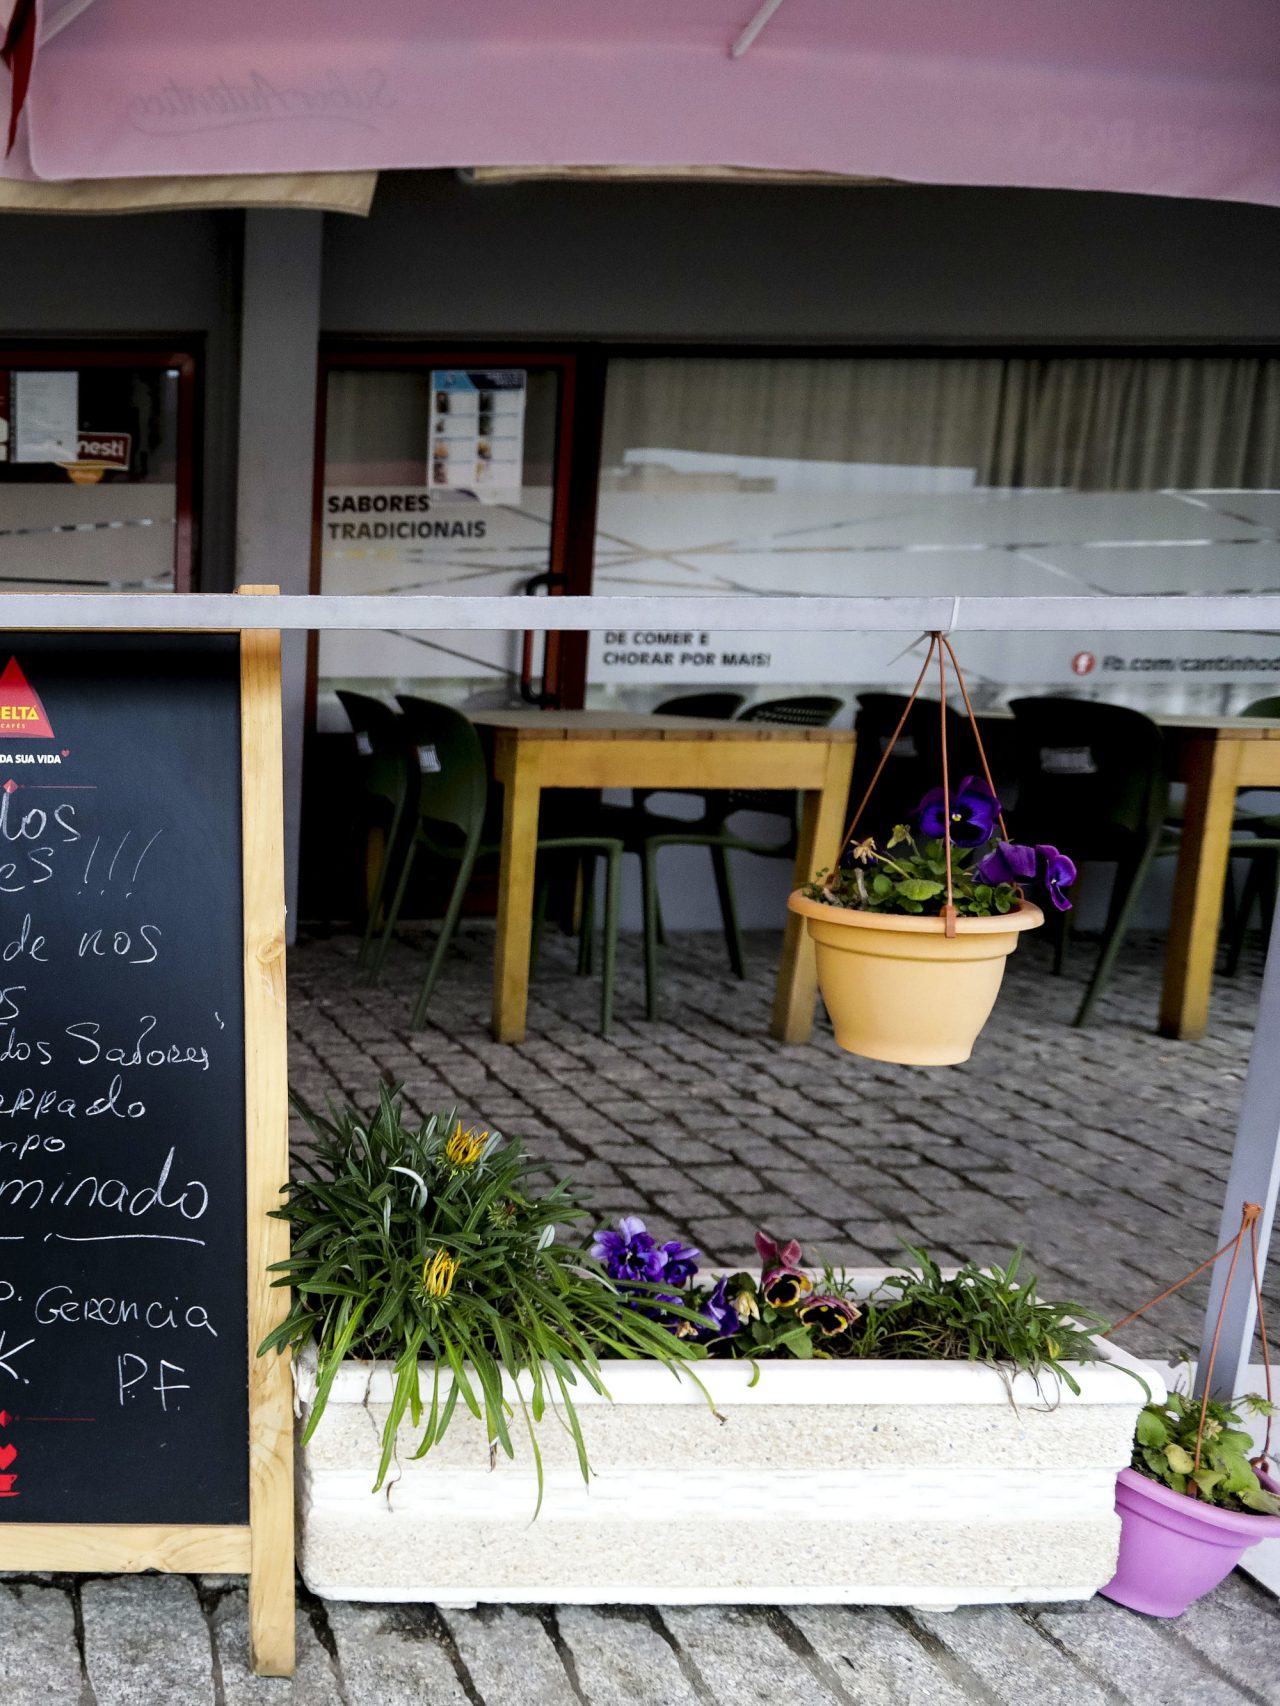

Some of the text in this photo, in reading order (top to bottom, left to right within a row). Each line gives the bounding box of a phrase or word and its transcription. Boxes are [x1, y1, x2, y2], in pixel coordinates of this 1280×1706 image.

[328, 494, 430, 513] SABORES
[328, 520, 486, 540] TRADICIONAIS
[604, 632, 626, 646] DE
[633, 632, 695, 646] COMER
[603, 651, 674, 667] CHORAR
[680, 652, 716, 667] POR
[0, 754, 14, 764] DA
[15, 754, 36, 764] SUA
[37, 755, 62, 764] VIDA
[2, 913, 49, 963] de
[0, 1027, 53, 1066] dos
